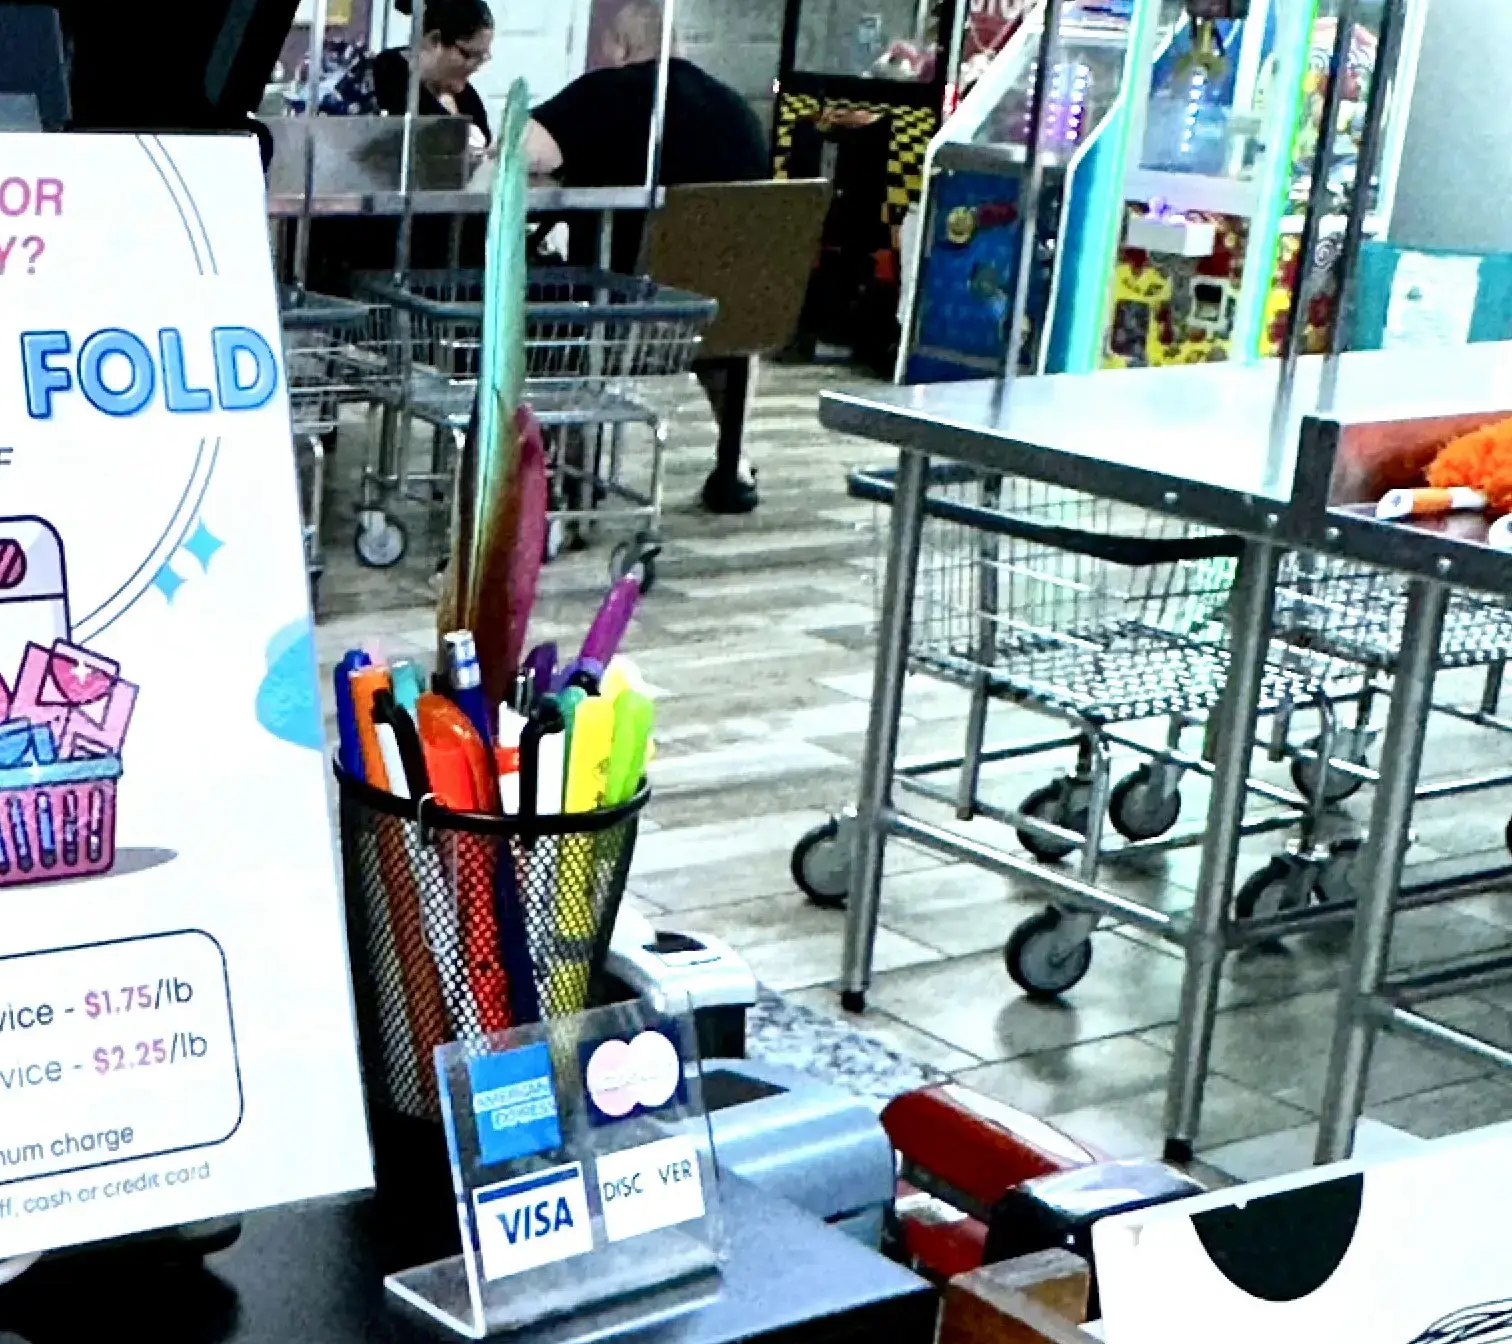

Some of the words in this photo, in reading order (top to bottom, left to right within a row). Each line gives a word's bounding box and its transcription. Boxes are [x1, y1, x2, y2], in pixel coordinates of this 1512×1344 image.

[20, 326, 279, 419] FOLD
[84, 976, 193, 1019] $1.75/lb
[92, 1032, 208, 1075] $2.25/lb
[50, 1126, 134, 1156] charge
[23, 1189, 72, 1214] cash
[78, 1186, 99, 1202] or
[103, 1172, 160, 1198] credit
[165, 1161, 211, 1186] card
[496, 1196, 574, 1246] VISA
